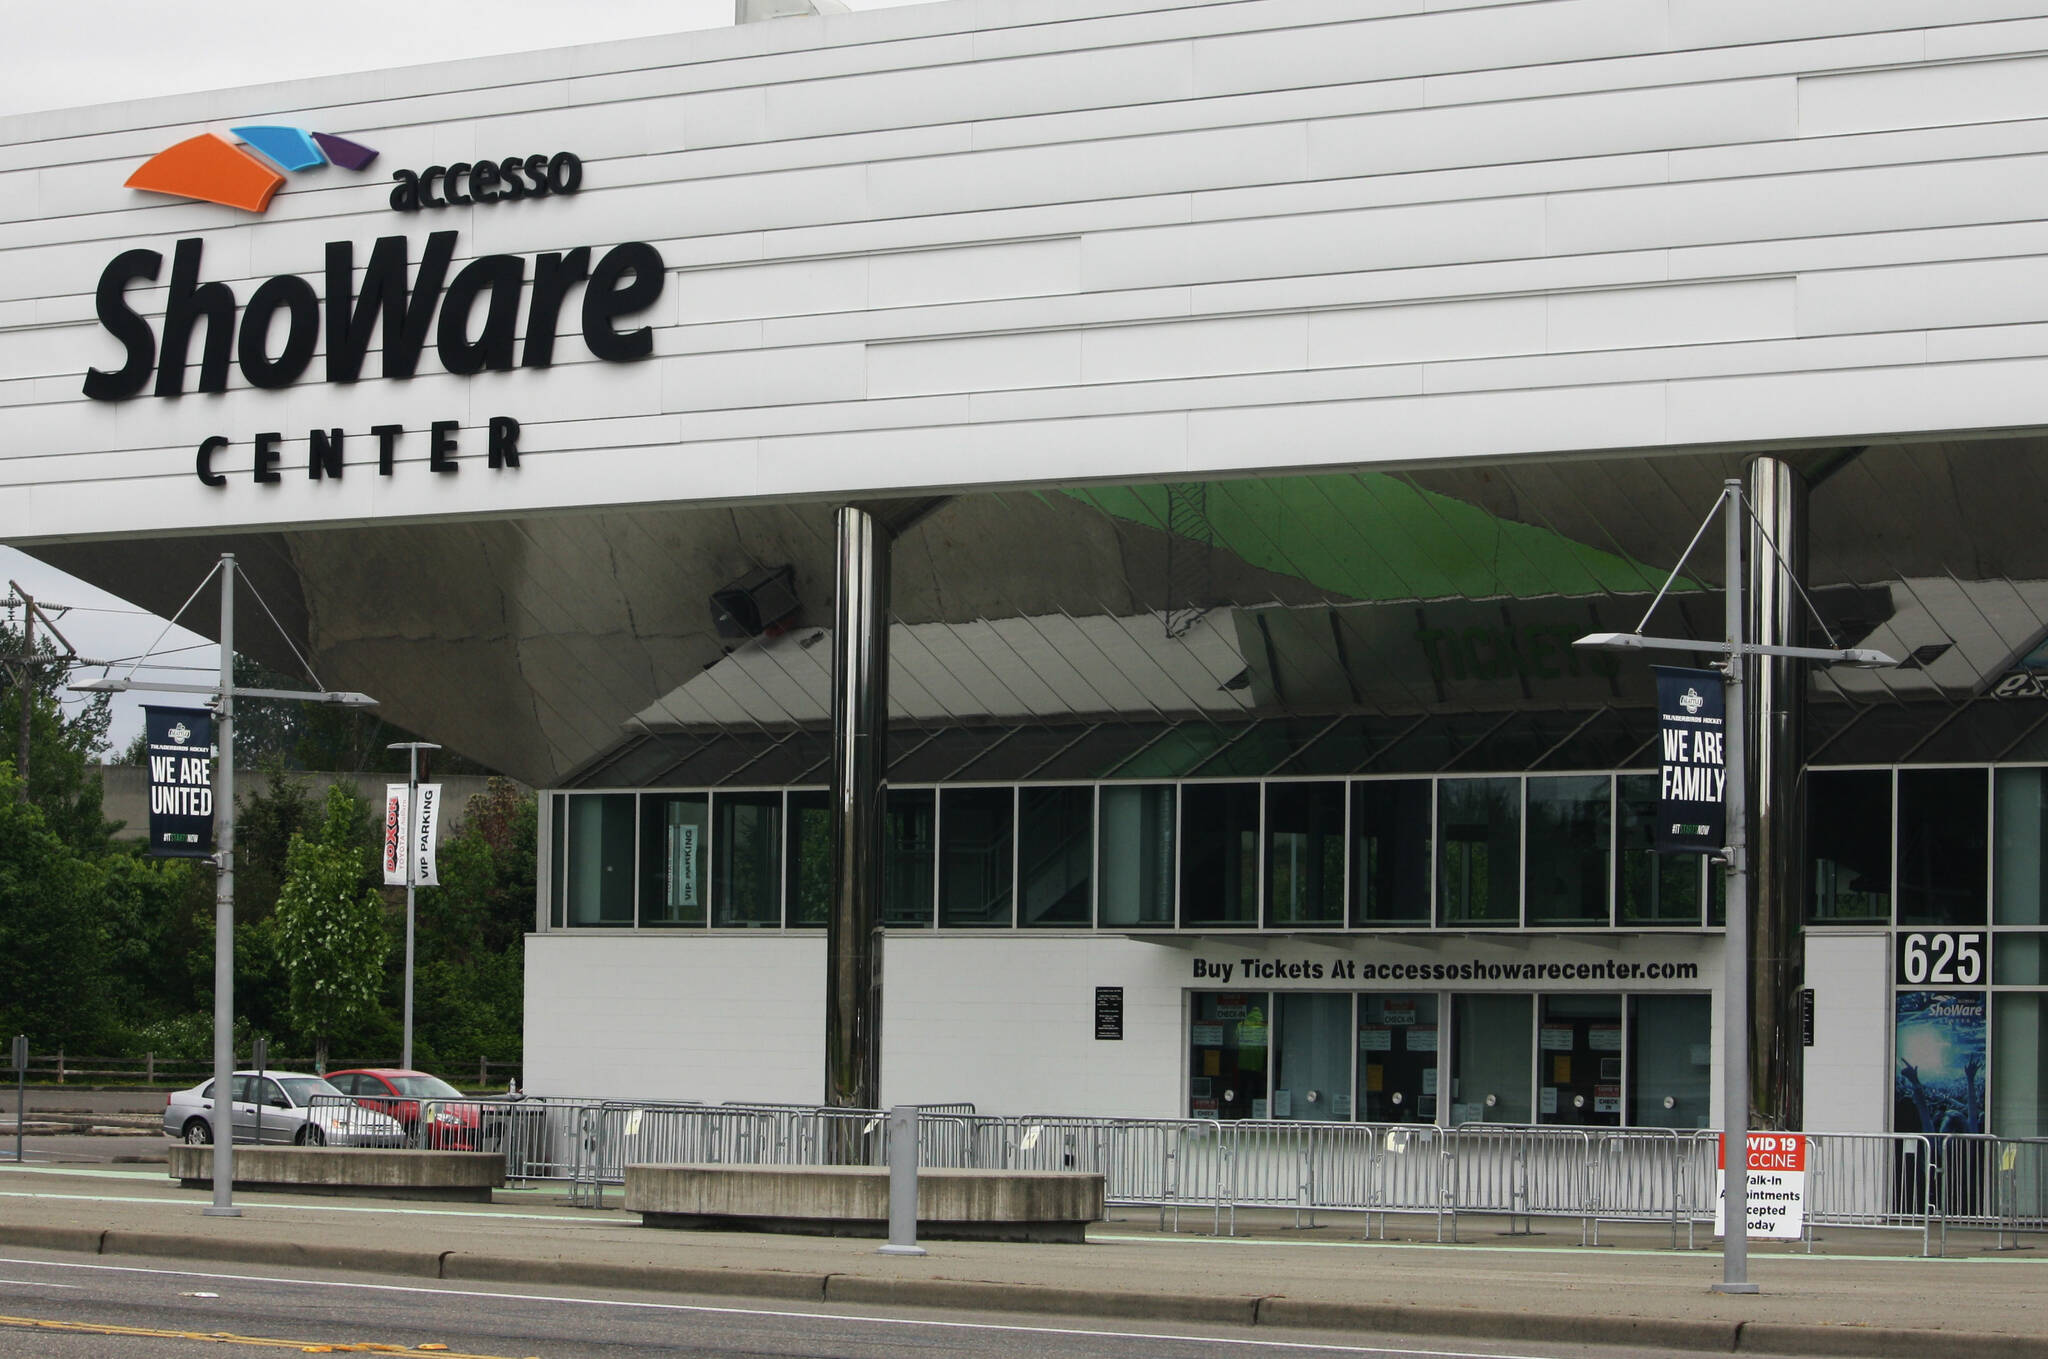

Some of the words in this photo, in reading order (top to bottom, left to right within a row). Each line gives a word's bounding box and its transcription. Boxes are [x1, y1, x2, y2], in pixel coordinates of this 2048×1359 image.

[390, 151, 582, 212] accesso
[82, 230, 666, 401] ShoWare
[196, 417, 520, 486] CENTER
[1662, 728, 1689, 763] WE
[1693, 731, 1724, 765] ARE
[150, 755, 177, 784] WE
[180, 757, 211, 786] ARE
[1661, 765, 1727, 803] FAMILY
[151, 785, 212, 817] UNITED
[386, 796, 399, 872] DOXON
[421, 790, 433, 851] PARKING
[421, 857, 429, 878] VIP
[1193, 958, 1234, 983] Buy
[1240, 958, 1324, 979] Tickets
[1331, 959, 1356, 979] At
[1363, 959, 1698, 980] accessoshowarecenter.com
[1903, 933, 1981, 984] 625
[1928, 1003, 1983, 1017] ShoWare
[1747, 1137, 1777, 1151] VID
[1780, 1137, 1797, 1151] 19
[1747, 1153, 1797, 1168] CCINE
[1746, 1205, 1786, 1217] cepted
[1747, 1220, 1776, 1232] oday
